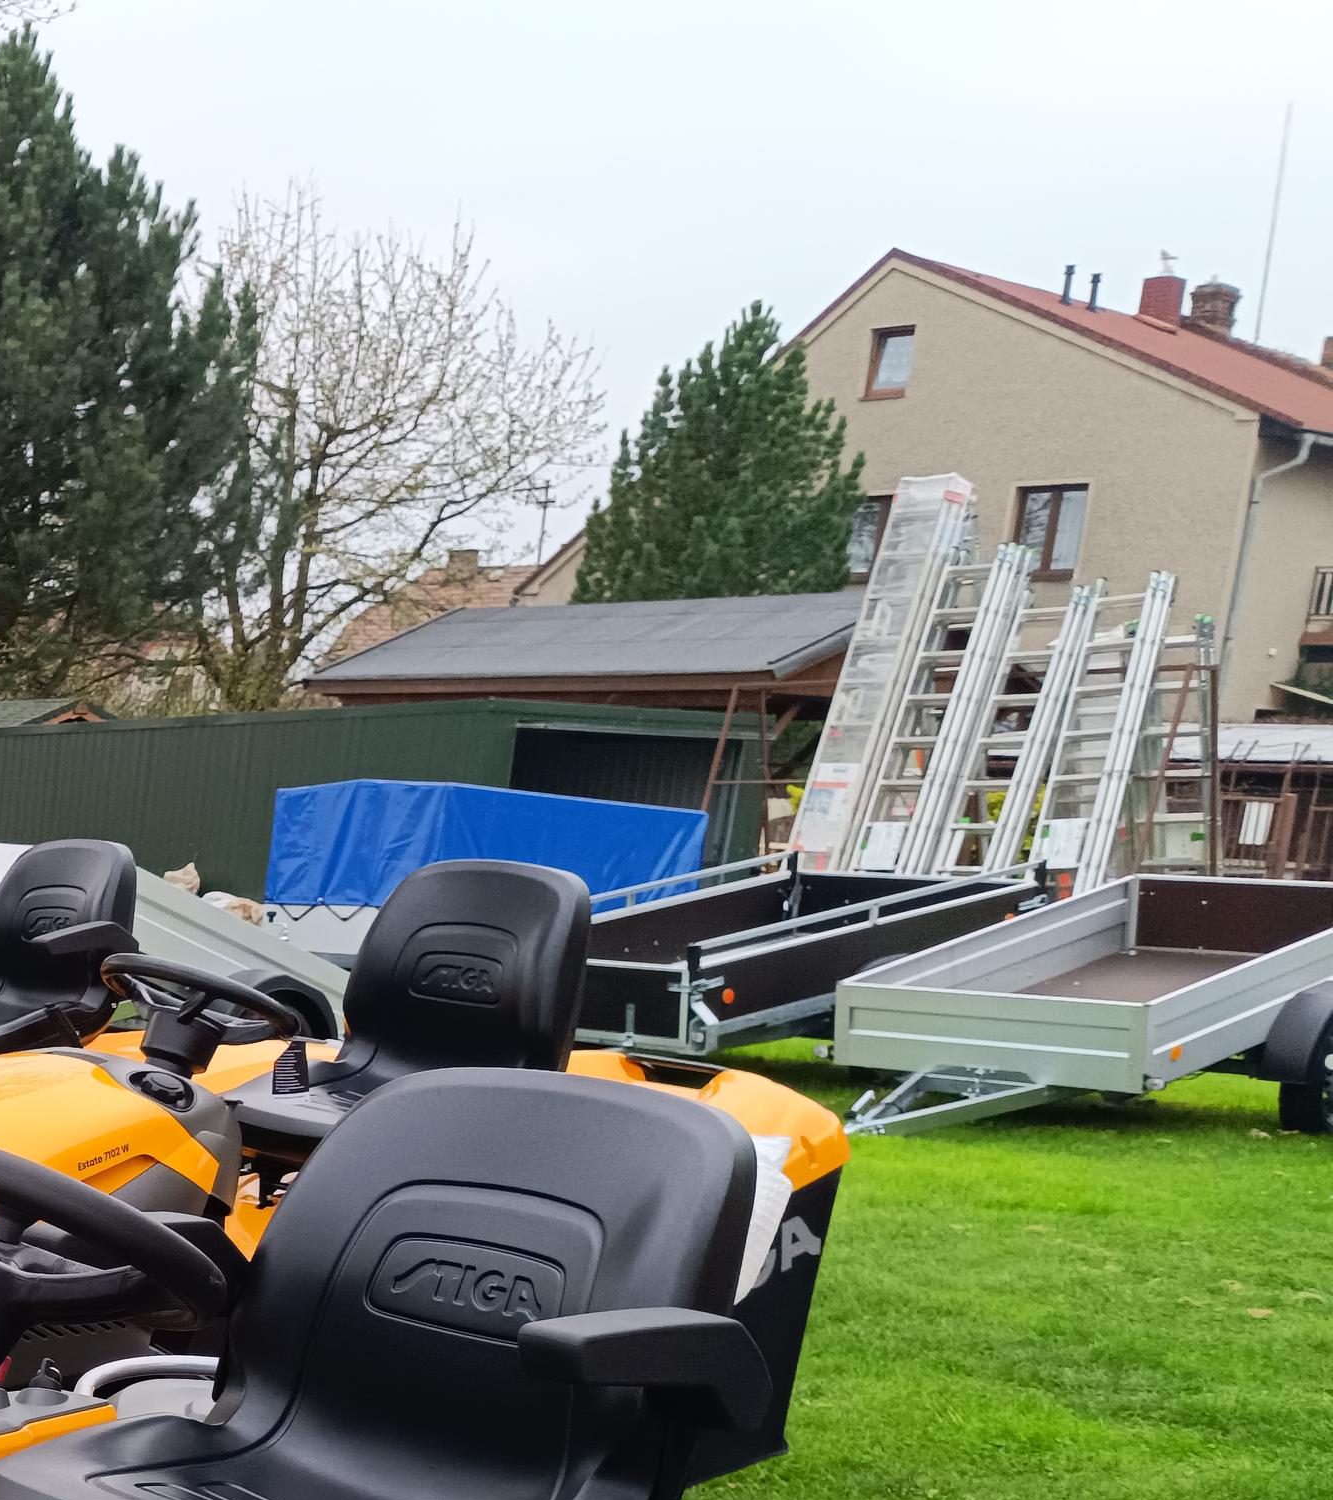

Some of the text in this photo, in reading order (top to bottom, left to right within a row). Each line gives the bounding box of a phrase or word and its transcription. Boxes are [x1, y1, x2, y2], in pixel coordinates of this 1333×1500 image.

[77, 1144, 129, 1171] Estate 7102 W
[390, 1257, 542, 1322] STIGA
